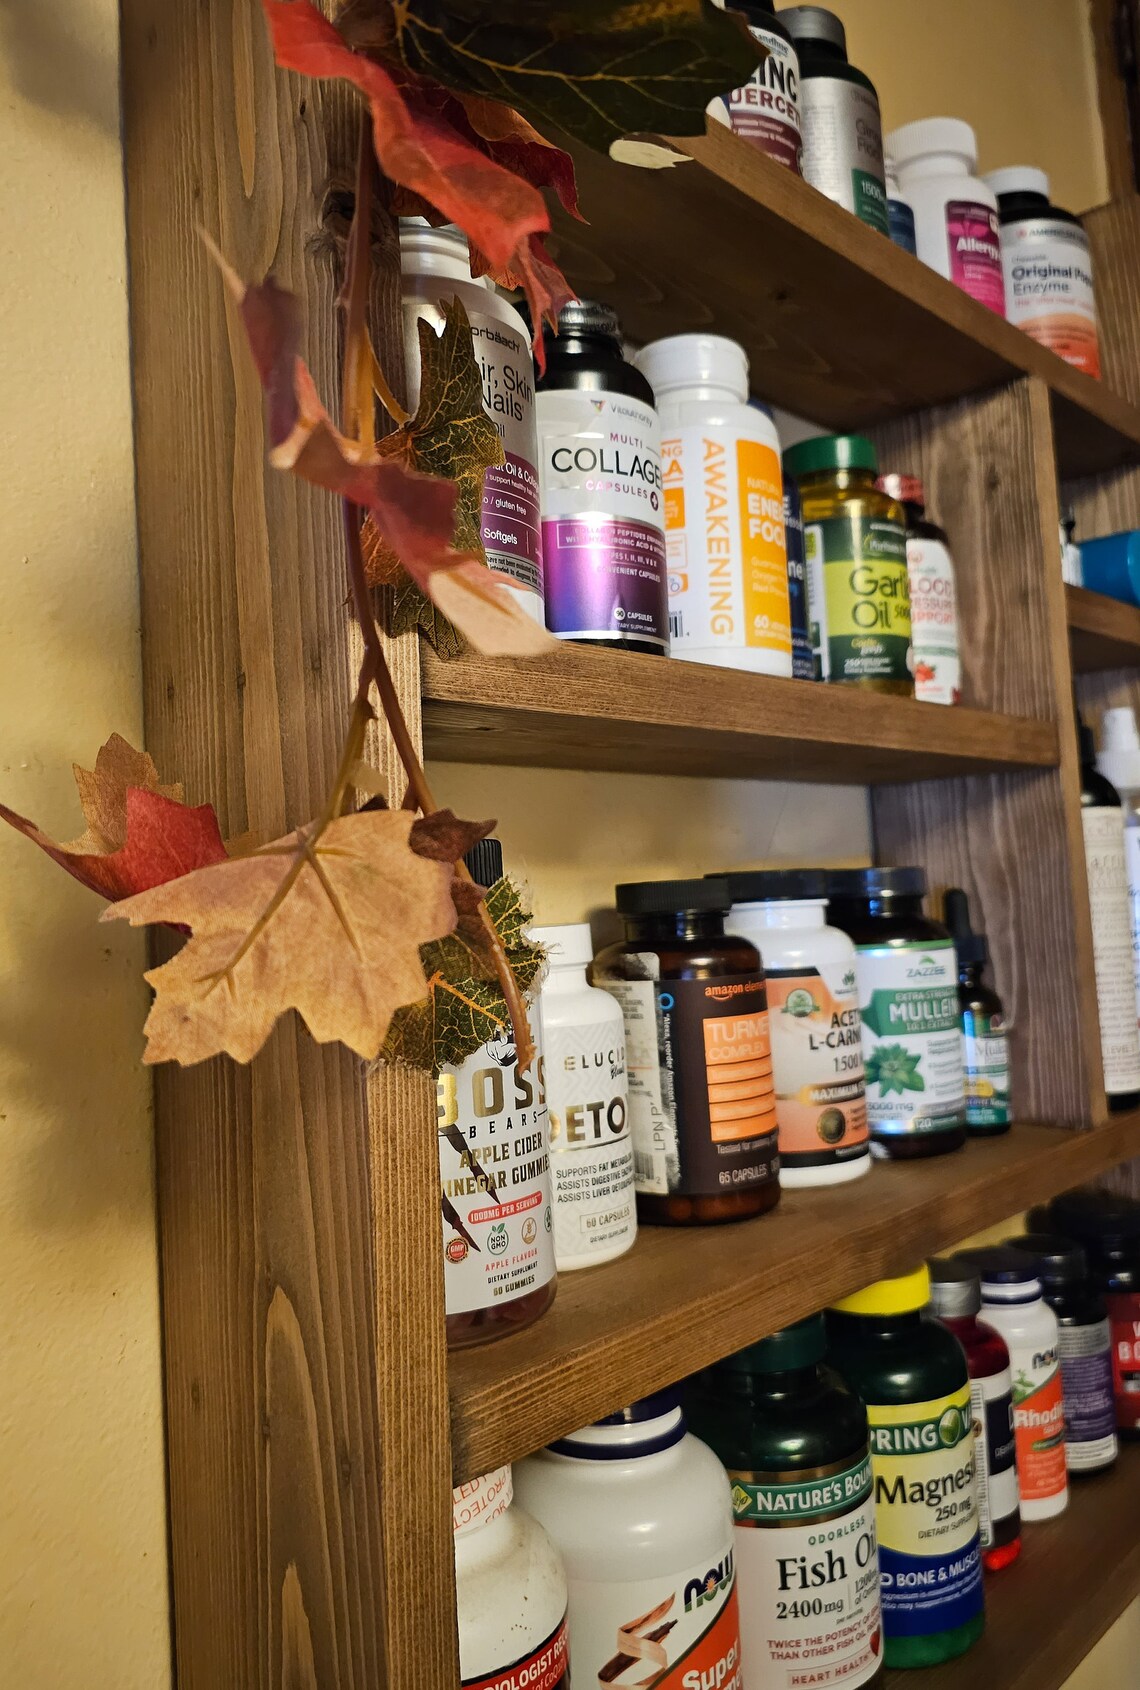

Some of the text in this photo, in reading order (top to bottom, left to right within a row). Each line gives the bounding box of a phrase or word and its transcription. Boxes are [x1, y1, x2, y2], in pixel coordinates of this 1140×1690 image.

[751, 56, 797, 103] INC
[1011, 265, 1072, 280] Original
[1013, 282, 1070, 296] Enzyme
[503, 365, 534, 406] Skin
[609, 432, 643, 449] MULTI
[505, 462, 524, 480] Oil &
[551, 447, 663, 490] COLLAGE
[585, 479, 648, 500] CAPSULES
[495, 498, 516, 510] gluten
[484, 527, 519, 545] Softgels
[617, 529, 646, 540] PEPTIDES
[701, 437, 735, 637] AWAKENING
[626, 611, 653, 623] CAPSULES
[851, 600, 892, 629] Oil
[704, 984, 744, 997] amazon
[833, 1052, 859, 1073] 1500
[469, 1110, 538, 1140] BEARS
[459, 1131, 543, 1168] APPLE CIDER
[512, 1153, 550, 1185] GUMMIE
[556, 1161, 609, 1179] SUPPORTS FAT
[557, 1169, 621, 1190] ASSISTS DIGESTIVE
[718, 1171, 731, 1185] 65
[731, 1163, 768, 1183] CAPSULES
[557, 1186, 611, 1203] ASSISTS LIVER
[501, 1203, 515, 1217] PER
[515, 1195, 538, 1212] SERVING
[598, 1206, 630, 1226] CAPSULES
[490, 1234, 506, 1244] NON
[491, 1242, 506, 1250] GMO
[485, 1247, 538, 1272] APPLE FLAVOUR
[487, 1261, 538, 1284] DIETARY SUPPLEMENT
[505, 1275, 535, 1294] GUMMIES
[935, 1502, 958, 1522] 250
[808, 1515, 866, 1546] ODORLESS
[917, 1524, 950, 1539] DIETARY
[776, 1550, 848, 1591] Fish
[896, 1569, 936, 1587] BONE
[937, 1567, 949, 1581] &
[767, 1638, 801, 1649] TWICE
[805, 1635, 823, 1647] THE
[825, 1619, 861, 1642] POTENCY
[771, 1630, 866, 1660] THAN OTHER FISH OIL
[681, 1637, 739, 1690] Super
[791, 1670, 831, 1685] HEART
